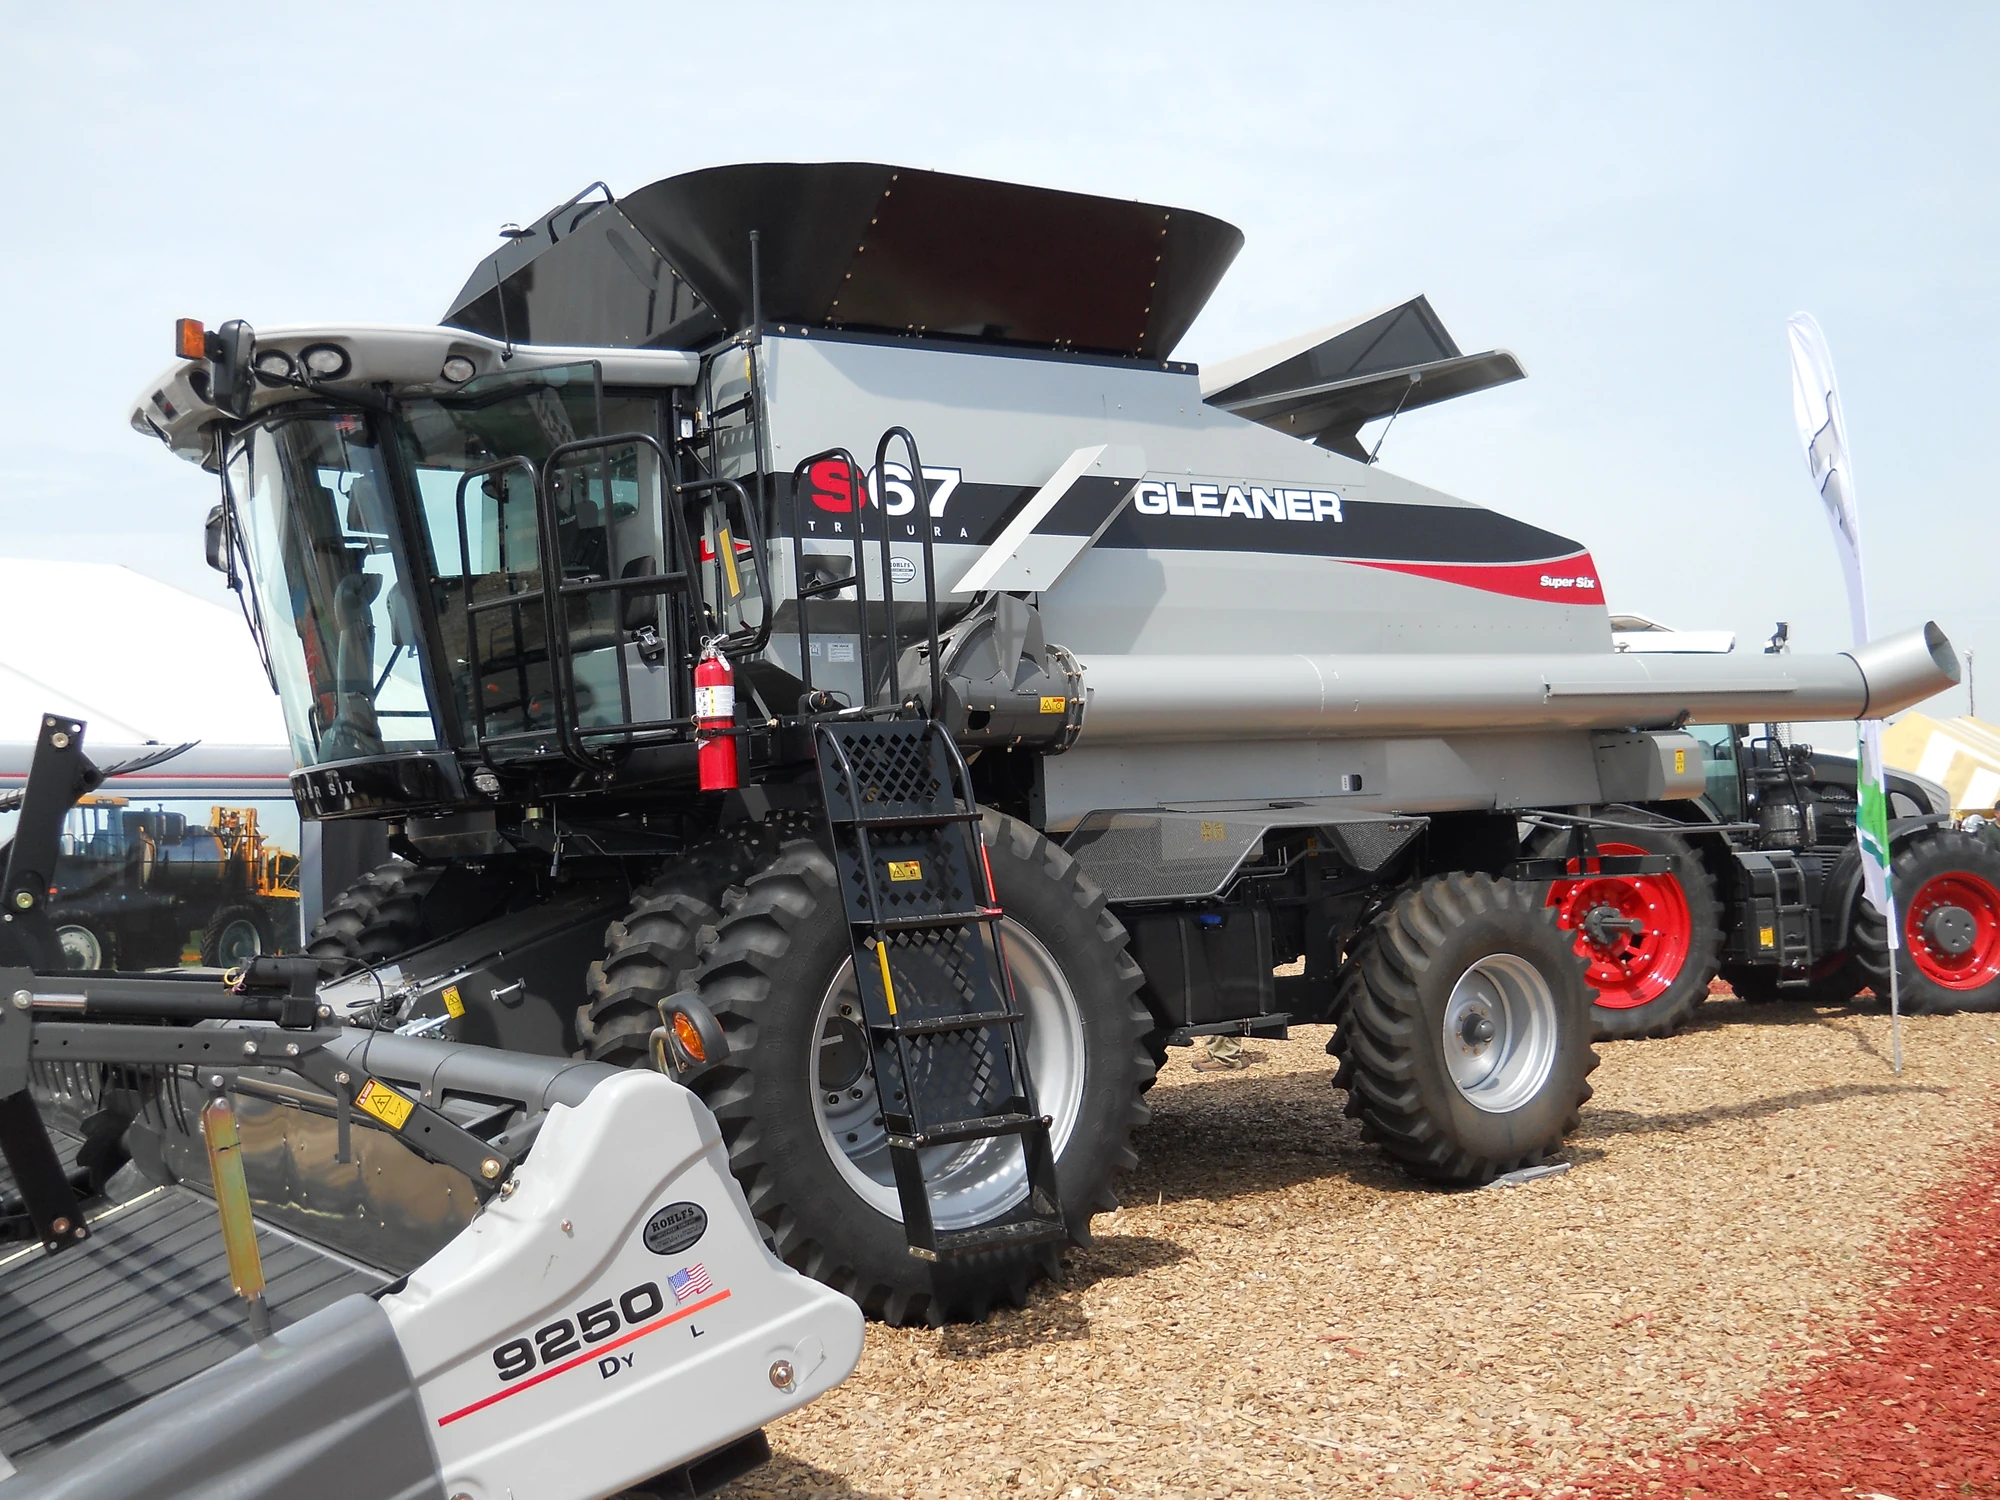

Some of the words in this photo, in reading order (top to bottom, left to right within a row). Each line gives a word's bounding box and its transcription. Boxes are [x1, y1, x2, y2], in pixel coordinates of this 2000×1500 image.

[811, 461, 961, 518] S67
[1134, 481, 1343, 523] GLEANER
[808, 521, 967, 538] TRIURA
[1540, 575, 1574, 589] Super
[1576, 577, 1595, 588] Six
[328, 781, 355, 796] SIX
[651, 1207, 694, 1232] ROHLFS
[492, 1281, 665, 1381] 9250
